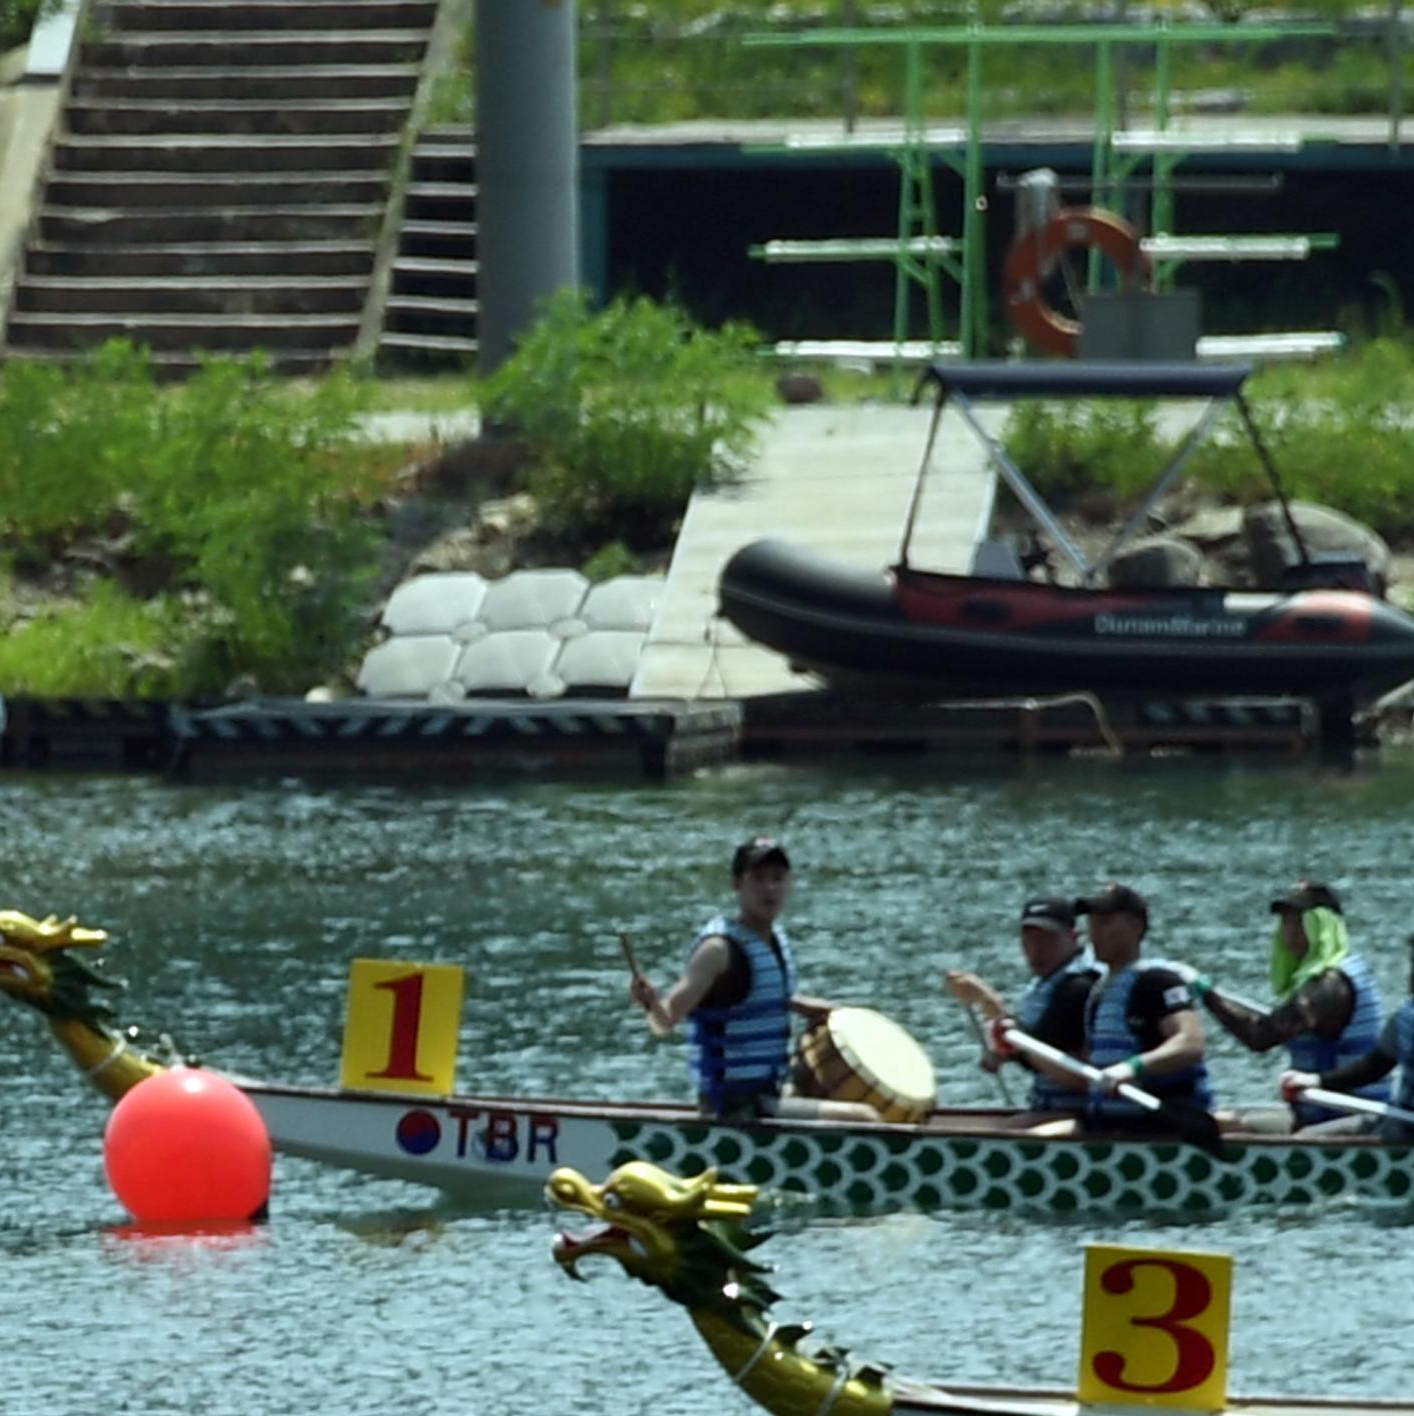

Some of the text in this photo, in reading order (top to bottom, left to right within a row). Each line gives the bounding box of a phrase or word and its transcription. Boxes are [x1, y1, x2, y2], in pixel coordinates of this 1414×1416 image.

[365, 972, 434, 1082] 1
[448, 1106, 559, 1163] TBR
[1092, 1258, 1215, 1393] 3
